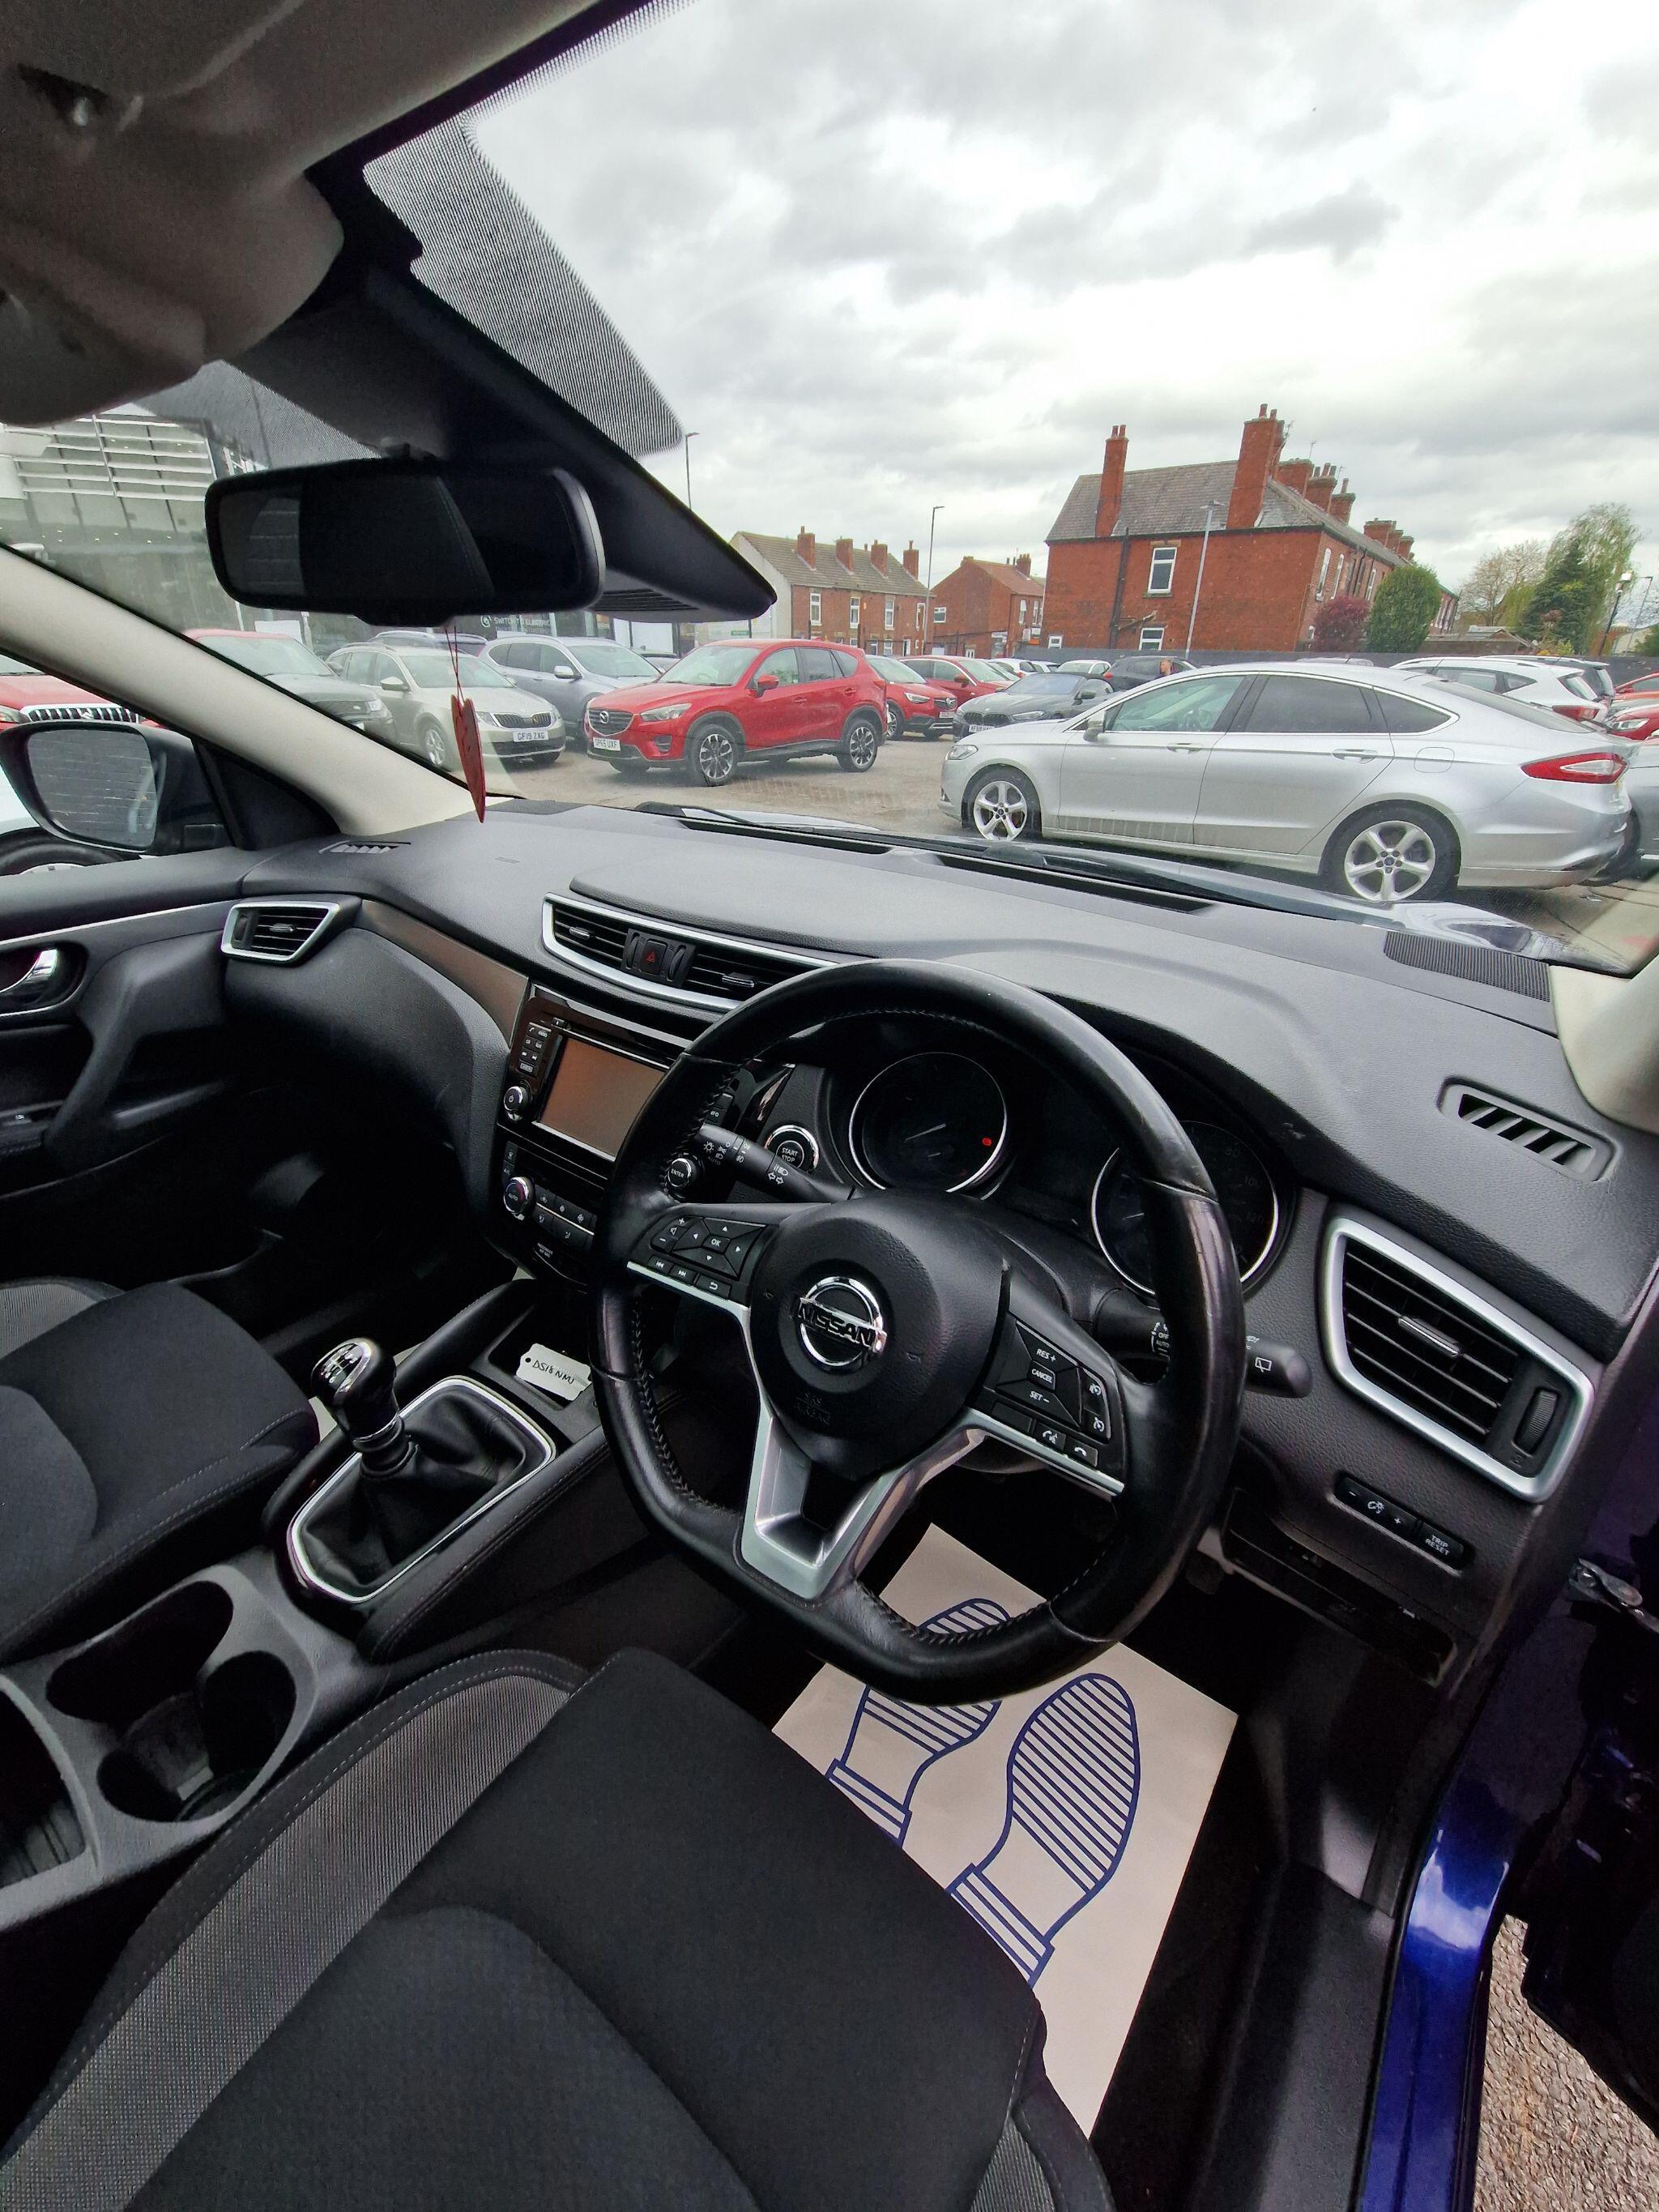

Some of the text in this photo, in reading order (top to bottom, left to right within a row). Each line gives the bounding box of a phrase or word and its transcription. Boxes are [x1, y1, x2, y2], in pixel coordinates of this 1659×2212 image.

[533, 731, 545, 739] ZXG
[781, 1147, 799, 1156] START
[708, 1156, 722, 1166] AUTO
[781, 1154, 795, 1162] STOP
[671, 1168, 684, 1177] ENTER
[710, 1238, 721, 1247] OK
[797, 1300, 875, 1348] NISSAN
[1155, 1340, 1170, 1348] AUTO
[1036, 1348, 1050, 1360] RES
[532, 1360, 554, 1373] DS18
[1031, 1369, 1053, 1383] CANCEL
[1030, 1390, 1043, 1401] SET
[1431, 1535, 1448, 1548] TRIP
[1425, 1539, 1450, 1556] RESET
